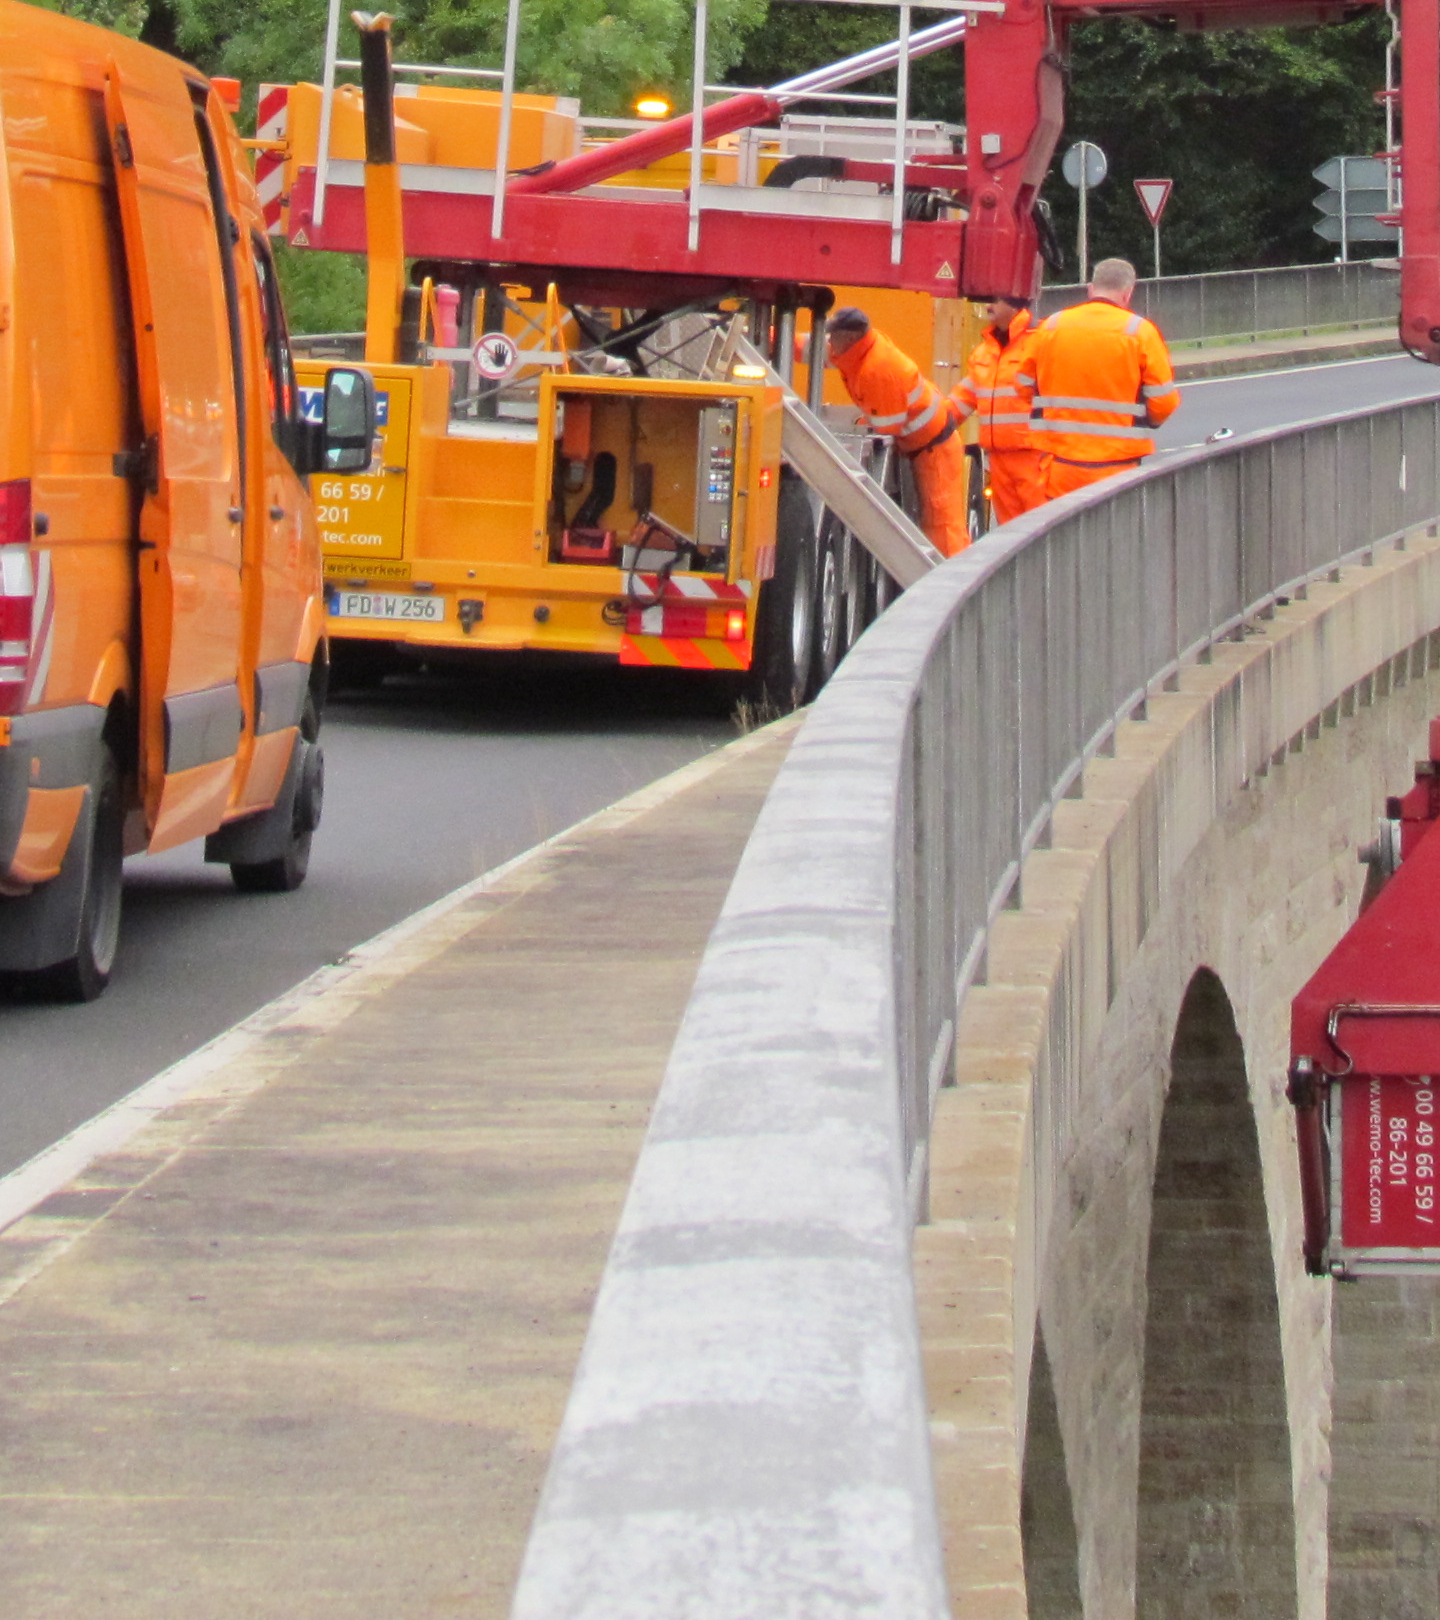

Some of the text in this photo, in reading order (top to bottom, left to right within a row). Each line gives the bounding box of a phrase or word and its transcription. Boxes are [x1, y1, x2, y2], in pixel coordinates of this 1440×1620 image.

[321, 482, 385, 501] 66 59 /
[317, 505, 350, 523] 201
[322, 530, 382, 546] tec.com
[346, 594, 436, 618] FD W 256
[1370, 1078, 1384, 1224] w.wemo-tec.com
[1389, 1117, 1407, 1185] 86-201
[1415, 1089, 1433, 1224] 00 49 66 59 /
